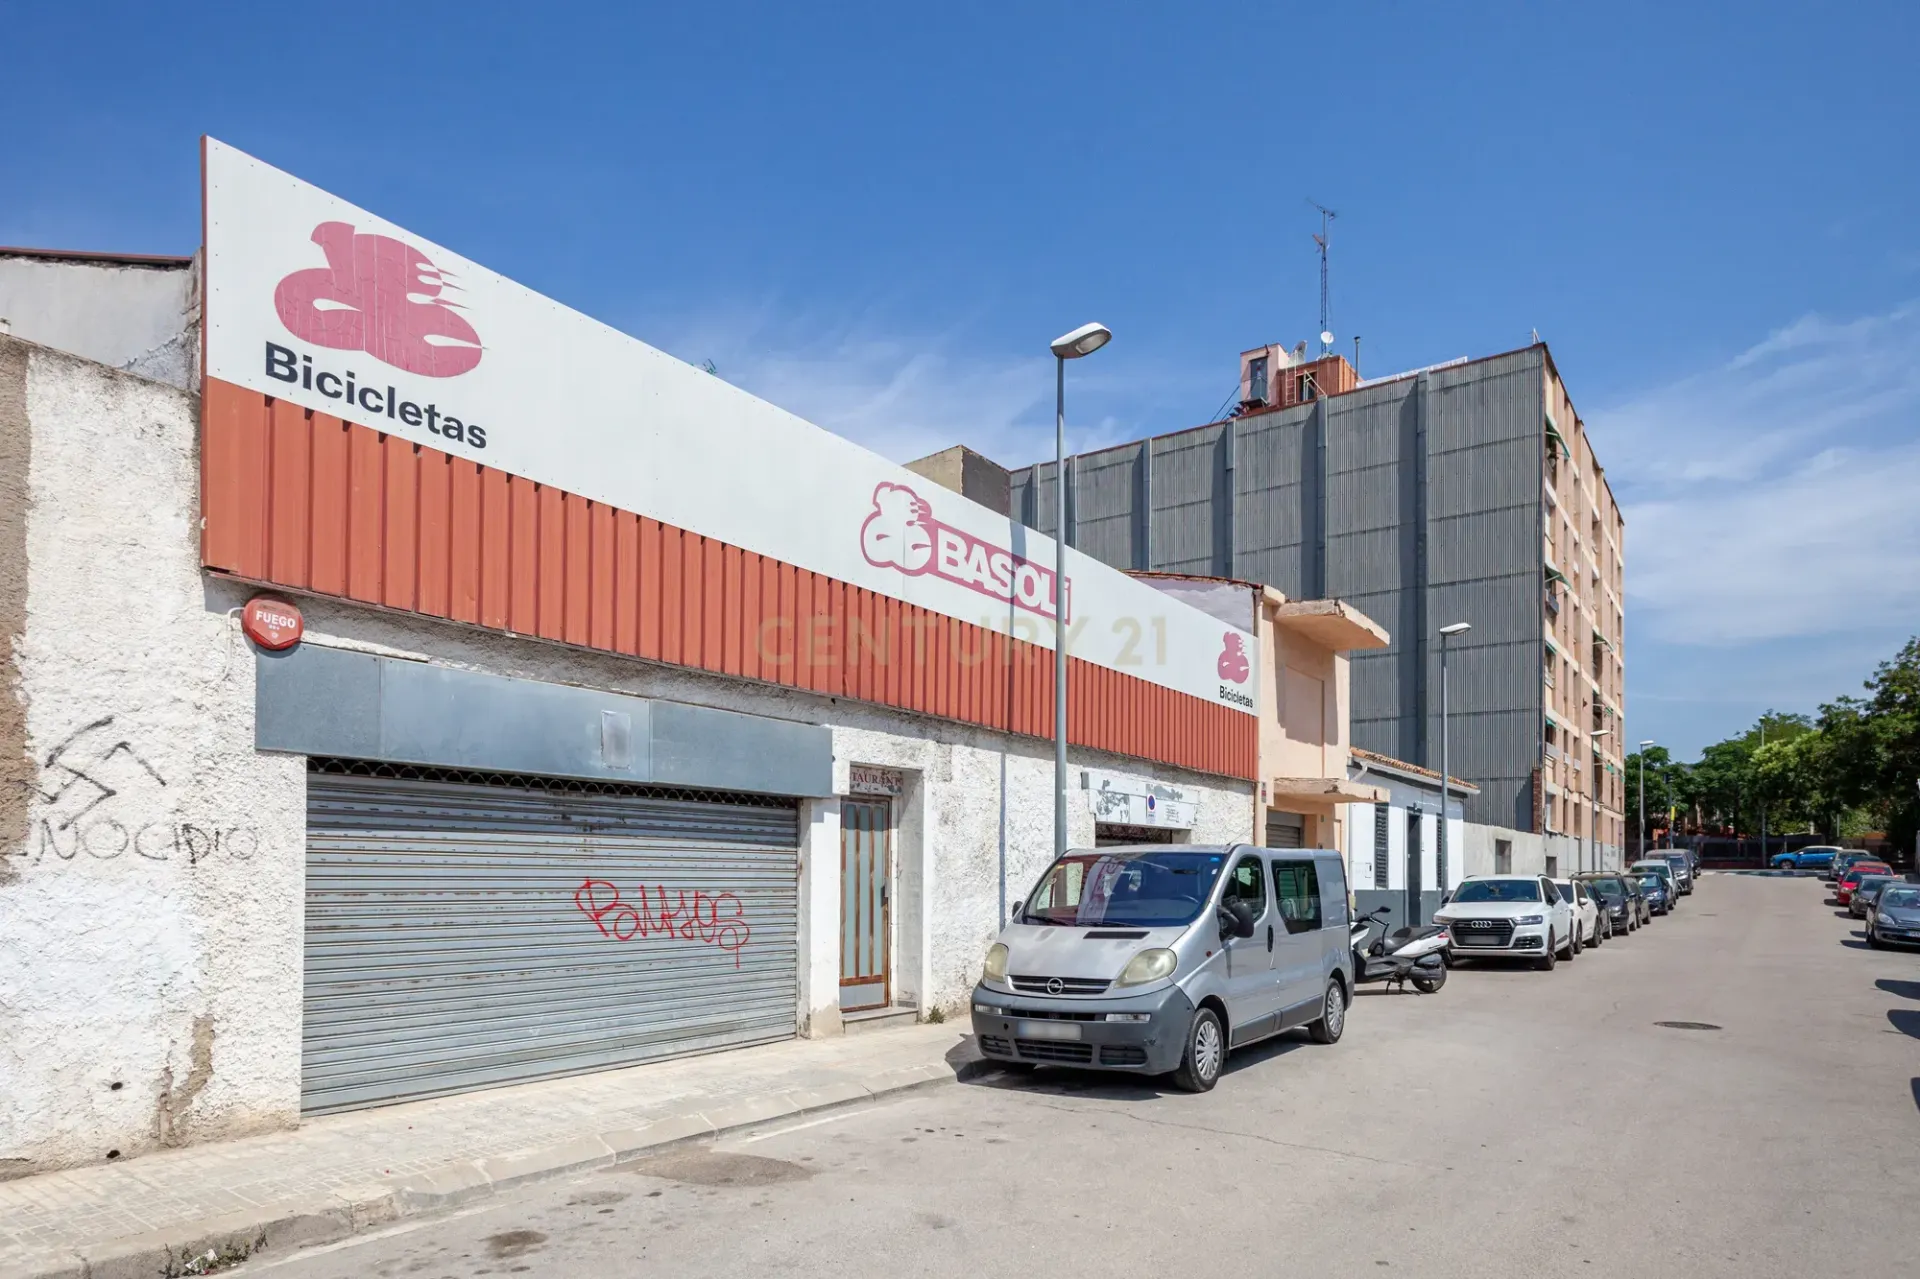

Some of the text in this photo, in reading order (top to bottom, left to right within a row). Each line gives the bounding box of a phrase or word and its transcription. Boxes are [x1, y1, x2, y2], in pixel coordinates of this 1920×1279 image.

[265, 340, 488, 450] Bicicletas
[255, 610, 296, 629] FUEGO
[1219, 684, 1254, 708] Bicicletas
